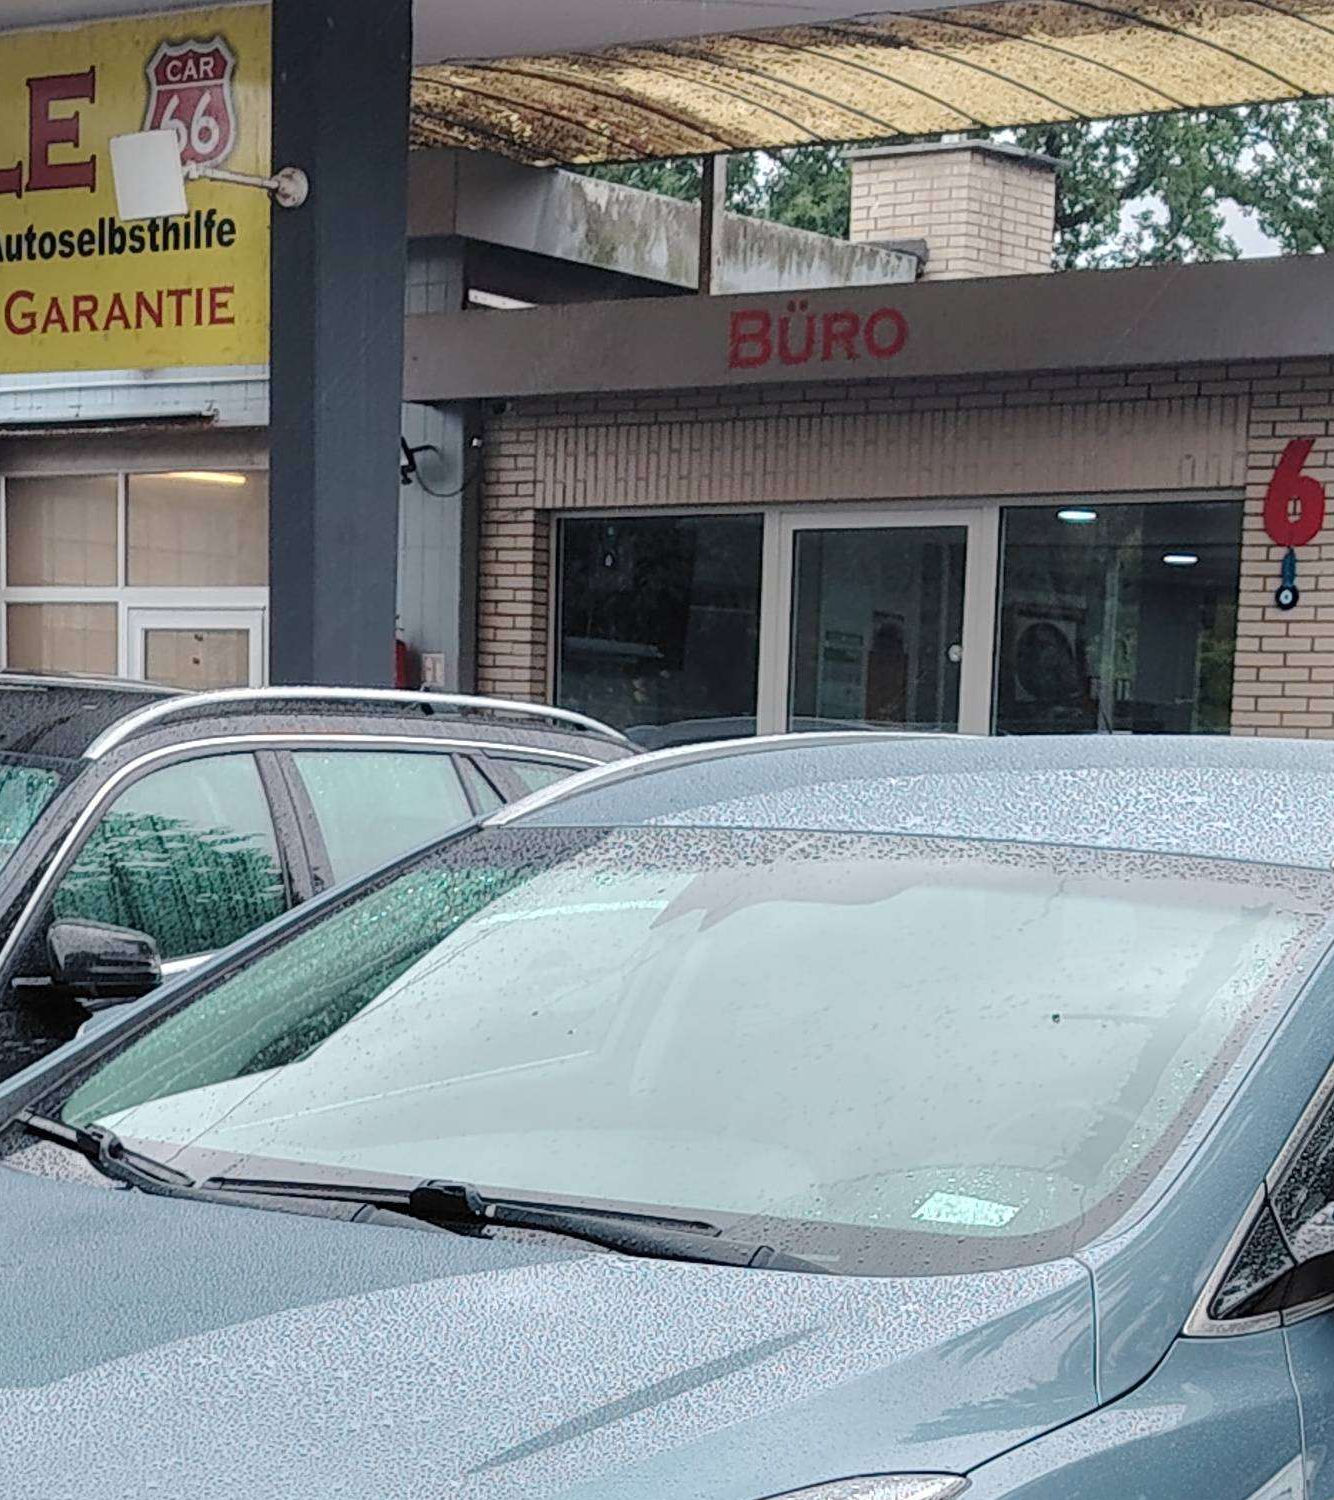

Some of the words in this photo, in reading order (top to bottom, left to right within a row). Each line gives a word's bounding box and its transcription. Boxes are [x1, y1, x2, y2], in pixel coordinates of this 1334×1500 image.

[165, 57, 215, 82] CAR
[4, 286, 236, 336] GARANTIE
[729, 300, 909, 369] BÜRO
